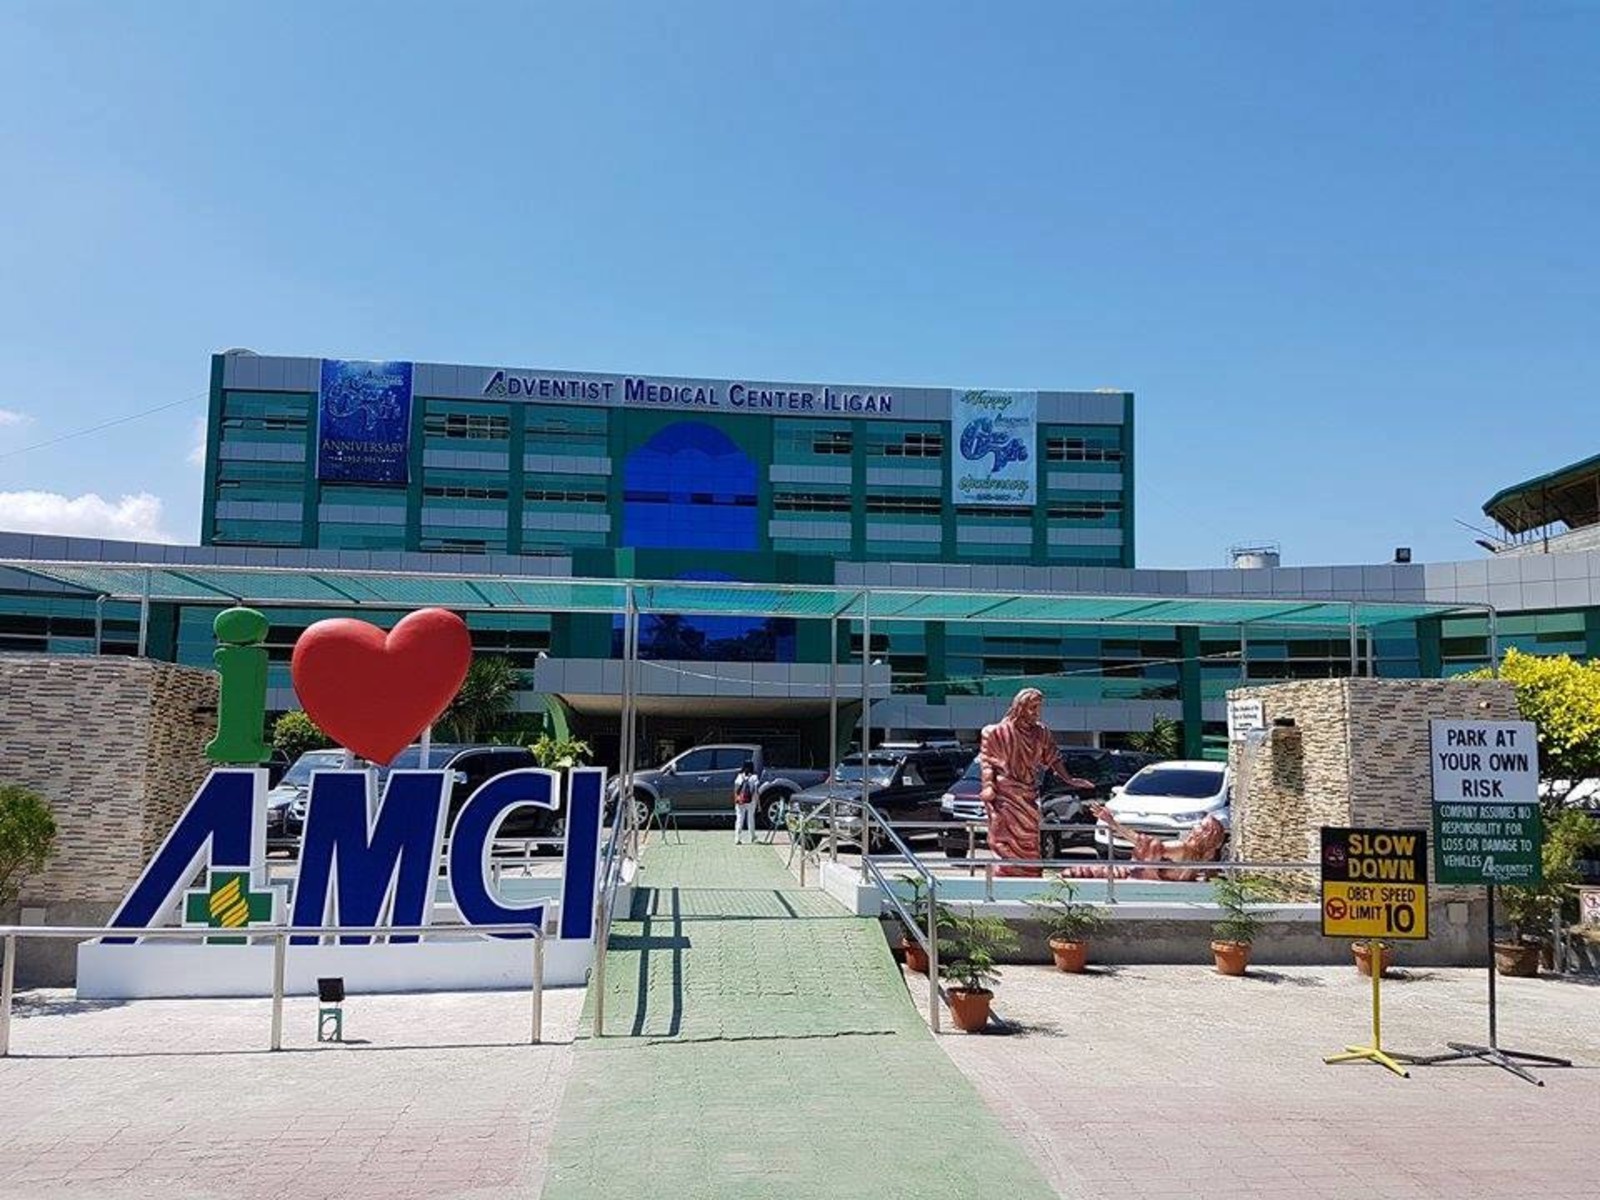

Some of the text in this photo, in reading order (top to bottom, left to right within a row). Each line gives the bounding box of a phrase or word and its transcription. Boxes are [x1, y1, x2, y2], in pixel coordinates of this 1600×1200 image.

[483, 370, 614, 399] ADVENTIST
[624, 378, 719, 406] MEDICAL
[1447, 729, 1517, 747] PARK AT
[1439, 753, 1529, 772] YOUR OWN
[1462, 779, 1504, 798] RISK
[1440, 806, 1531, 819] COMPANY ASSUMES NO
[1441, 823, 1523, 836] RESPONSIBILITY FOR
[1348, 833, 1416, 856] SLOW
[1441, 838, 1533, 852] LOSS OR DAMAGE TO
[100, 767, 607, 946] AMCI
[1443, 855, 1482, 868] VEHICLES
[1348, 858, 1415, 880] DOWN
[1347, 886, 1416, 903] OBEY SPEED
[1349, 903, 1416, 933] LIMIT 10
